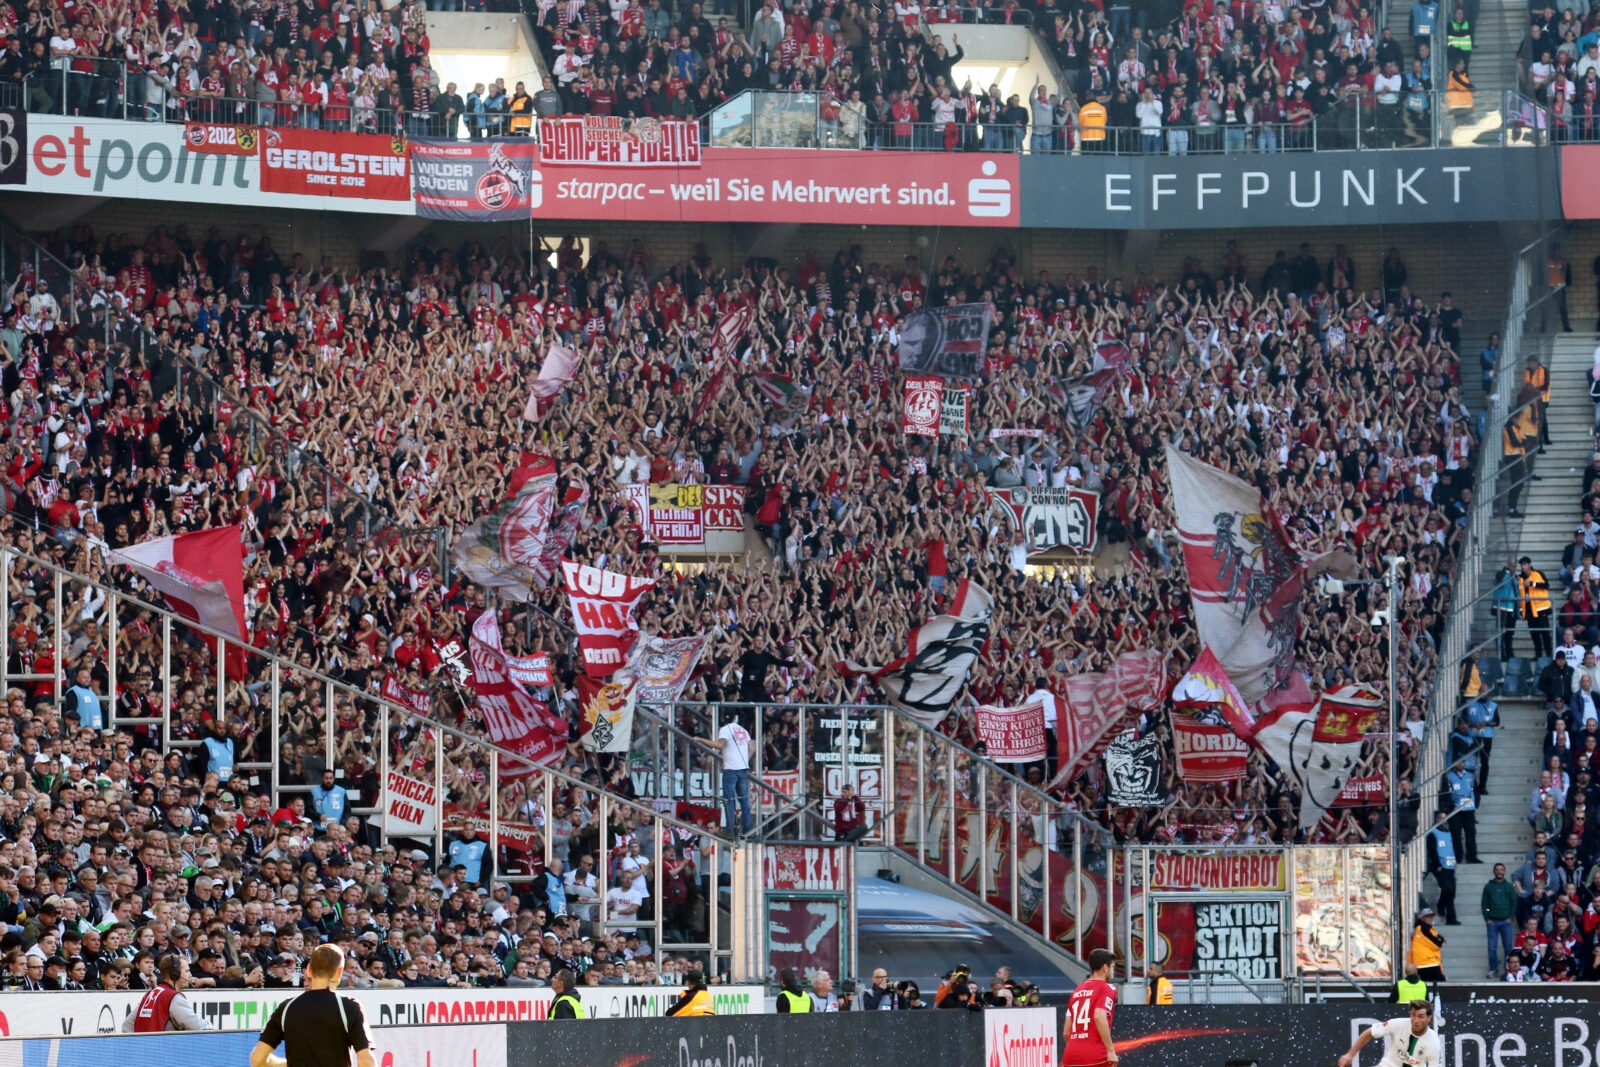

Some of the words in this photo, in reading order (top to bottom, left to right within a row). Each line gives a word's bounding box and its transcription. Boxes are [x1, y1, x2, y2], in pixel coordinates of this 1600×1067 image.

[585, 117, 604, 128] VOLL
[607, 117, 621, 128] DIE
[207, 126, 236, 145] 2012
[266, 147, 406, 176] GEROLSTEIN
[417, 162, 473, 177] WILDER
[307, 173, 337, 185] SINCE
[340, 176, 366, 187] 2012
[418, 175, 468, 191] SÜDEN
[557, 179, 646, 202] starpac
[672, 177, 720, 203] weil
[727, 178, 765, 202] Sie
[772, 179, 892, 206] Mehrwert
[897, 181, 957, 207] sind.
[705, 487, 745, 505] SPS
[1031, 496, 1051, 505] CON
[1053, 496, 1068, 505] NOI
[705, 508, 744, 526] CGN
[562, 561, 627, 597] TOD
[583, 648, 621, 664] DEM
[860, 718, 877, 729] FÜR
[979, 719, 1008, 731] EINER
[1011, 716, 1043, 730] KURVE
[979, 729, 1005, 739] WIRD
[1008, 731, 1022, 740] AN
[1025, 725, 1043, 738] DER
[1011, 734, 1045, 749] IHRER
[1176, 730, 1247, 752] HORDE
[389, 800, 425, 825] KÖLN
[1154, 853, 1281, 889] STADIONVERBOT
[1199, 904, 1278, 927] SEKTION
[1199, 926, 1278, 959] STADT
[1199, 957, 1278, 980] VERBOT
[1072, 999, 1091, 1032] 14
[1003, 1023, 1053, 1067] Santander
